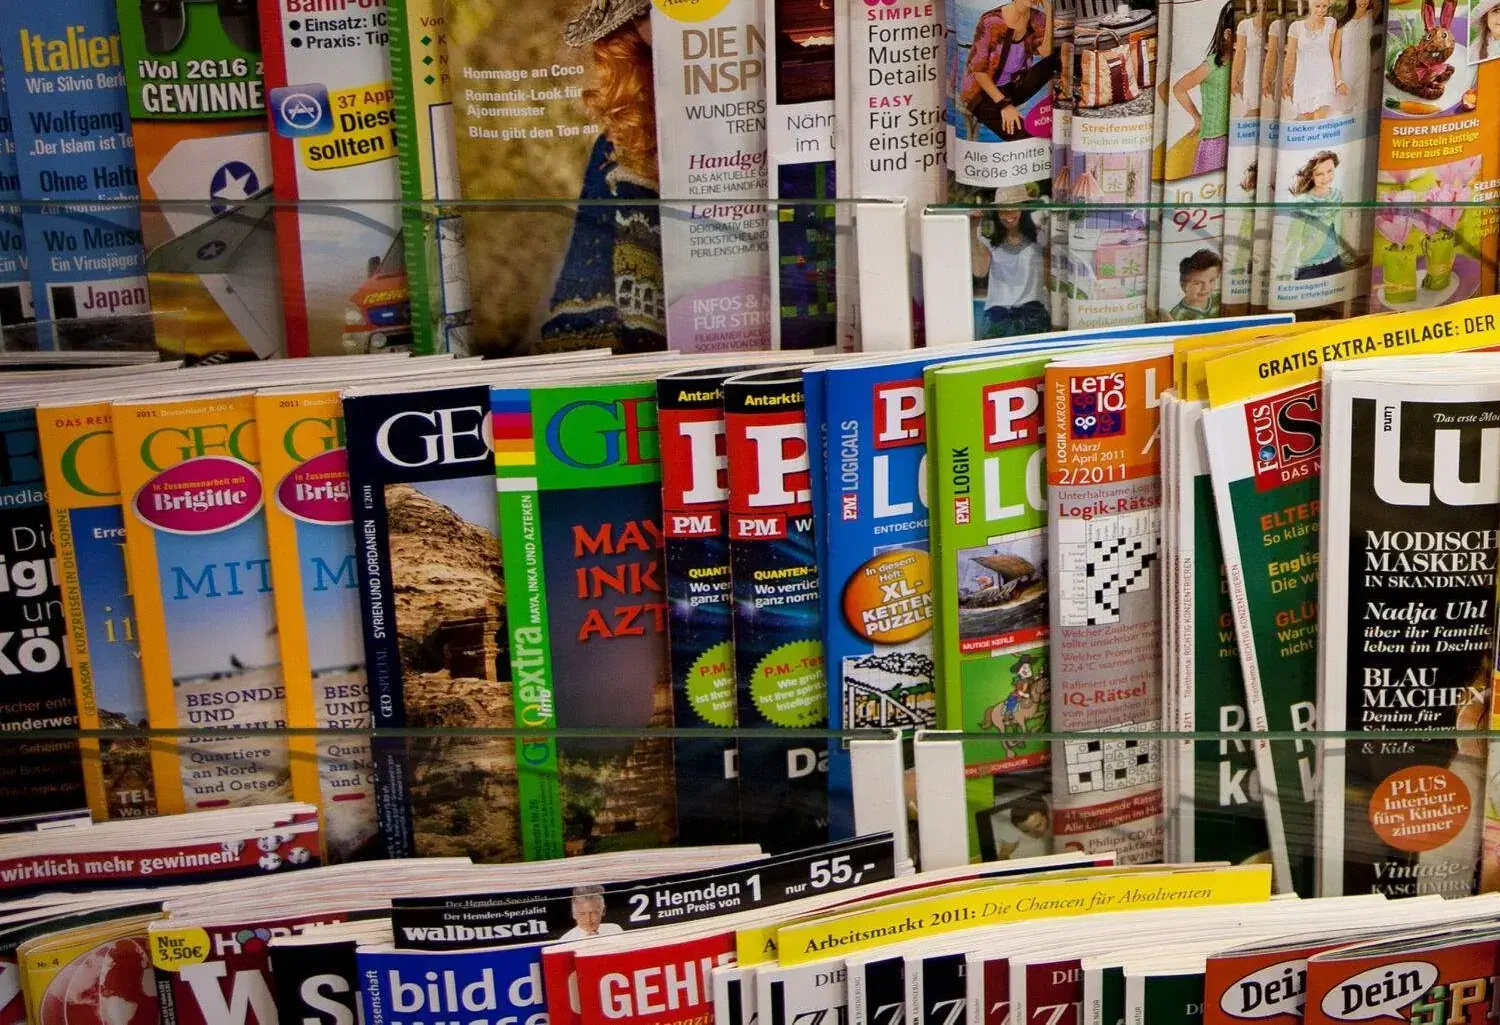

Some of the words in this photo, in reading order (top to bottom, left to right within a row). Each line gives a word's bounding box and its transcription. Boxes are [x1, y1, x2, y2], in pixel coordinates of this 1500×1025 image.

[305, 16, 366, 30] Einsatz:
[869, 42, 938, 63] Muster
[869, 63, 937, 85] Details
[1392, 124, 1427, 135] SUPER
[1430, 120, 1479, 133] NIEDLICH:
[308, 136, 384, 162] sollten
[83, 285, 144, 310] Japan
[1258, 350, 1319, 379] GRATIS
[1321, 324, 1461, 362] EXTRA-BEILAGE:
[1464, 314, 1497, 334] DER
[953, 447, 969, 497] LOGIK
[1059, 463, 1127, 484] 2/2011
[154, 487, 248, 513] Brigitte
[1363, 602, 1430, 622] Nadja
[1439, 601, 1487, 619] Uhl
[1363, 668, 1438, 688] BLAU
[1390, 777, 1447, 794] PLUS
[1383, 791, 1456, 813] Interieur
[1, 859, 81, 882] wirklich
[85, 858, 136, 874] mehr
[141, 848, 240, 875] gewinnen!
[657, 881, 739, 908] Hemden
[657, 904, 683, 919] zum
[686, 900, 716, 914] Preis
[719, 897, 740, 910] von
[402, 918, 548, 941] walbusch
[804, 917, 925, 954] Arbeitsmarkt
[930, 908, 977, 928] 2011:
[981, 900, 1011, 917] Die
[1016, 893, 1085, 914] Chancen
[1087, 890, 1112, 913] für
[1118, 887, 1212, 905] Absolventen
[1341, 972, 1423, 1017] Dein
